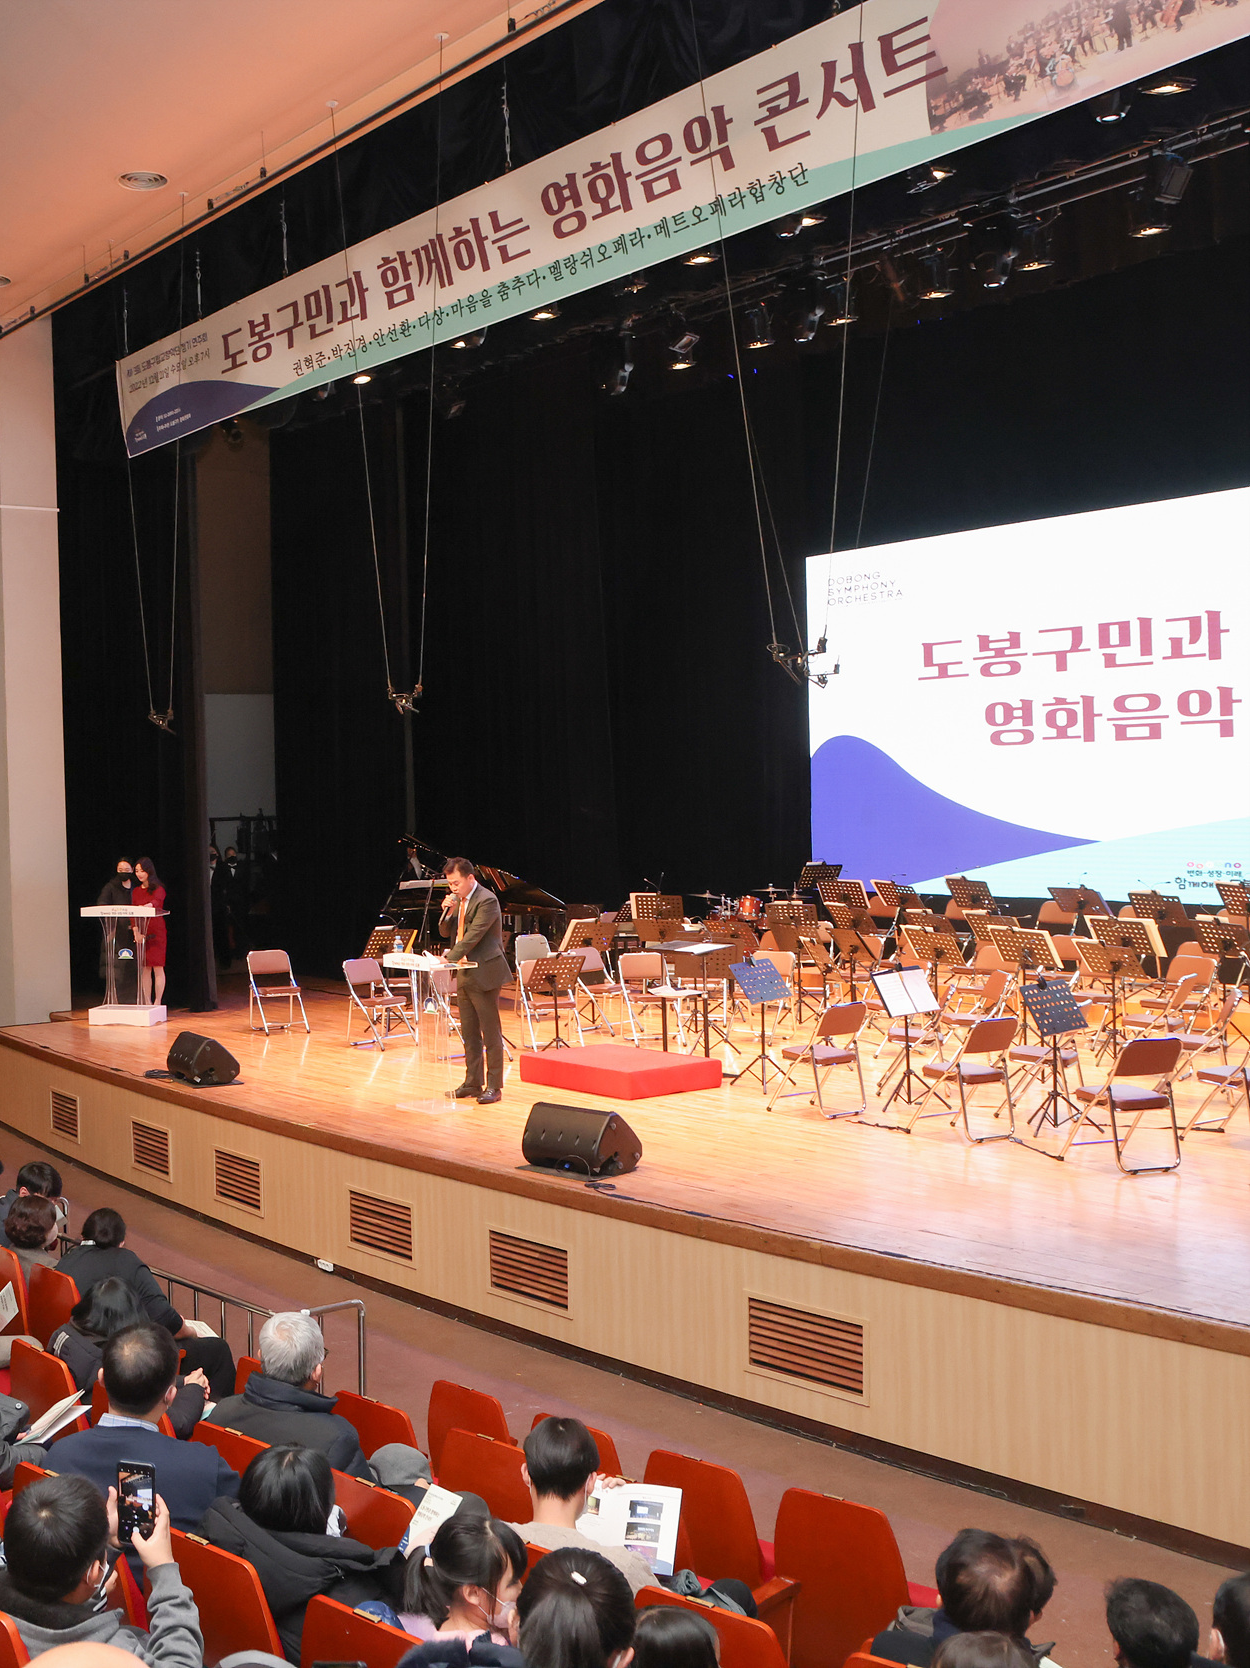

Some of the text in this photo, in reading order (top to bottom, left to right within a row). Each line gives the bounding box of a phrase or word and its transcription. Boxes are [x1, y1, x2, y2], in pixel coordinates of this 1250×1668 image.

[221, 16, 948, 374] 도봉구민과 함께하는 영화음악 콘서트
[827, 589, 903, 606] ORCHESTRA
[828, 571, 881, 587] DOBONG
[828, 580, 896, 597] SYMPHONY
[918, 610, 1230, 681] 도봉구민과
[985, 686, 1242, 746] 영화음악
